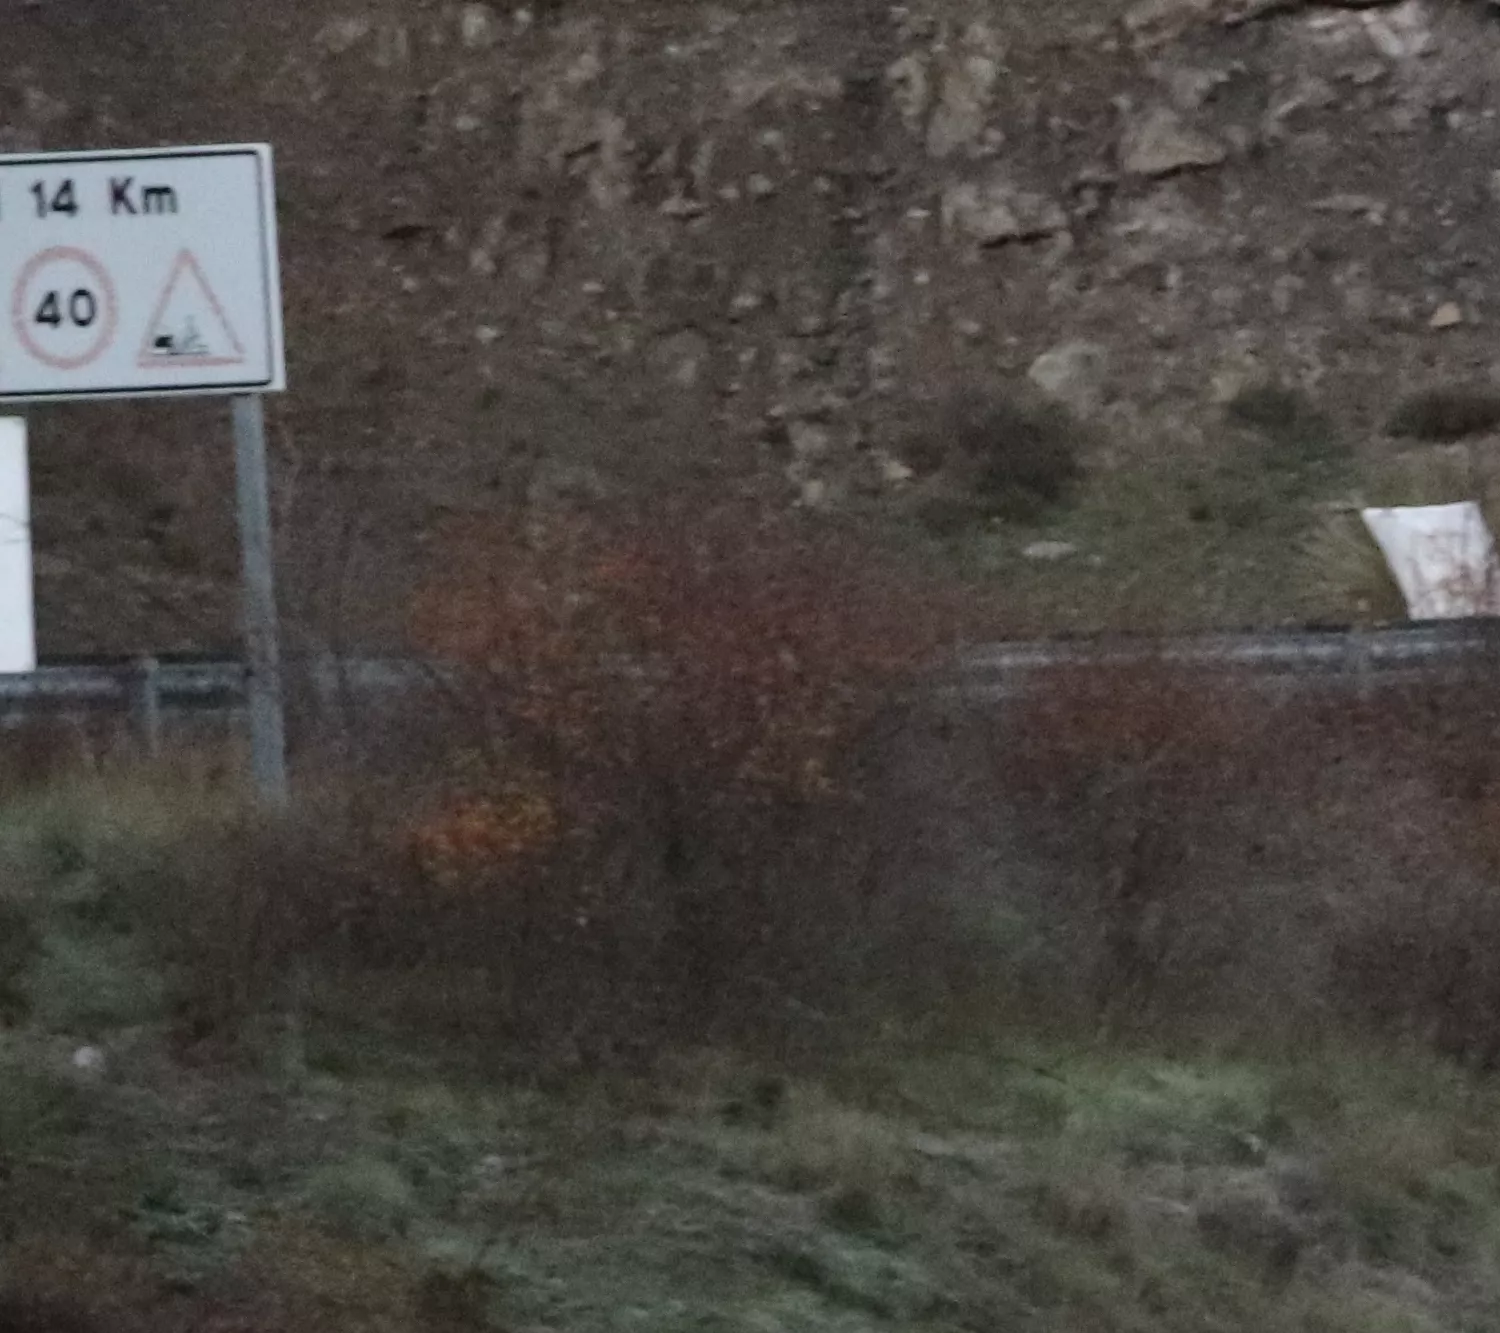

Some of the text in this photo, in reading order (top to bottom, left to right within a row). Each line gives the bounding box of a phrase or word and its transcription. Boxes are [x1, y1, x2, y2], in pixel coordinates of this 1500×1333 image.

[29, 176, 179, 218] 14 Km
[34, 288, 97, 329] 40
